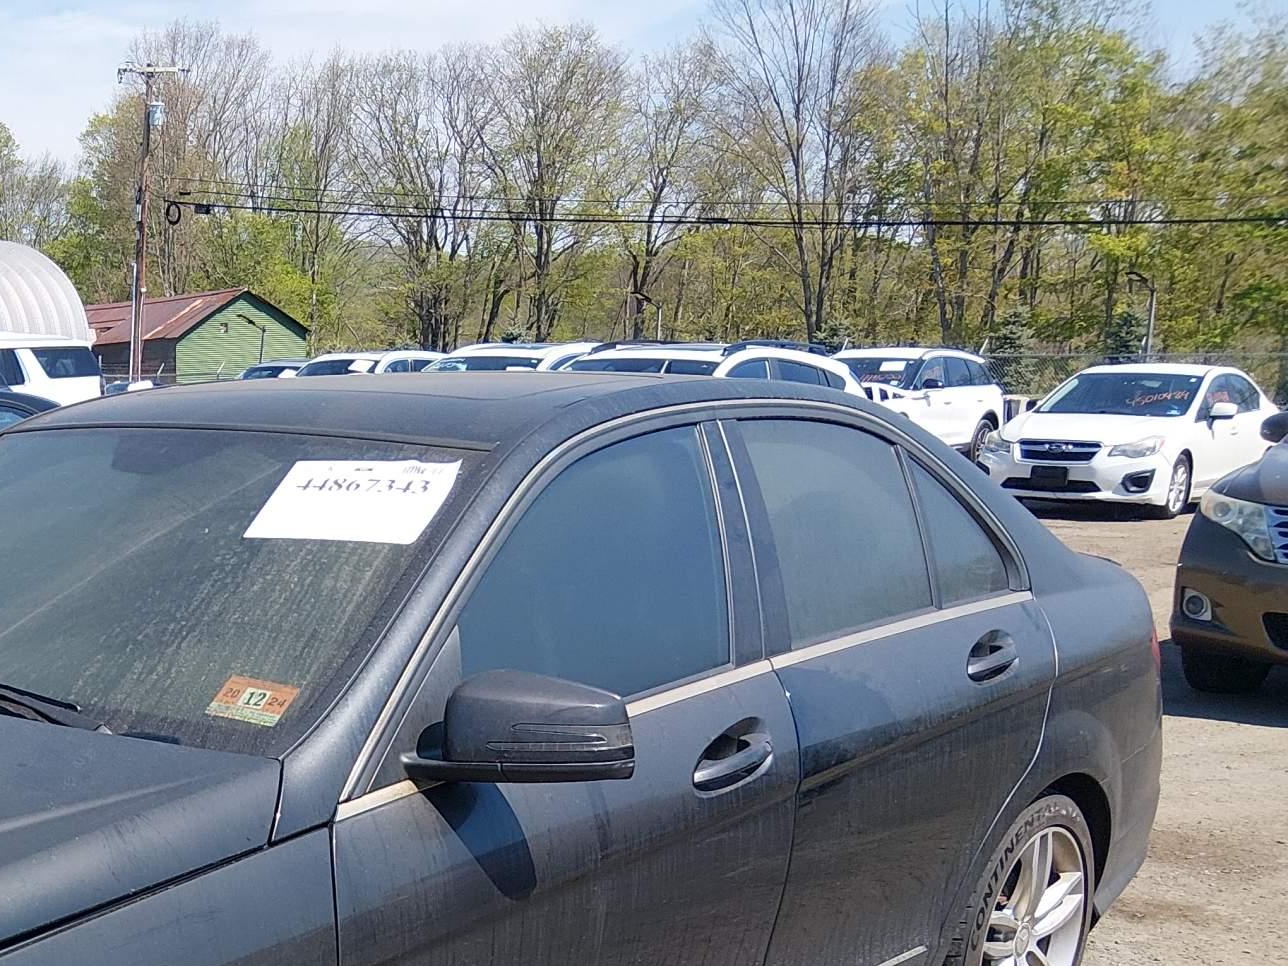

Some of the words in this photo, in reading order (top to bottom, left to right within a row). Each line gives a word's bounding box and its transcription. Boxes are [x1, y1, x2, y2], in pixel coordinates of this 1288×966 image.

[296, 477, 430, 493] 44867343
[222, 687, 240, 698] 20
[243, 691, 267, 707] 12
[268, 697, 287, 708] 24
